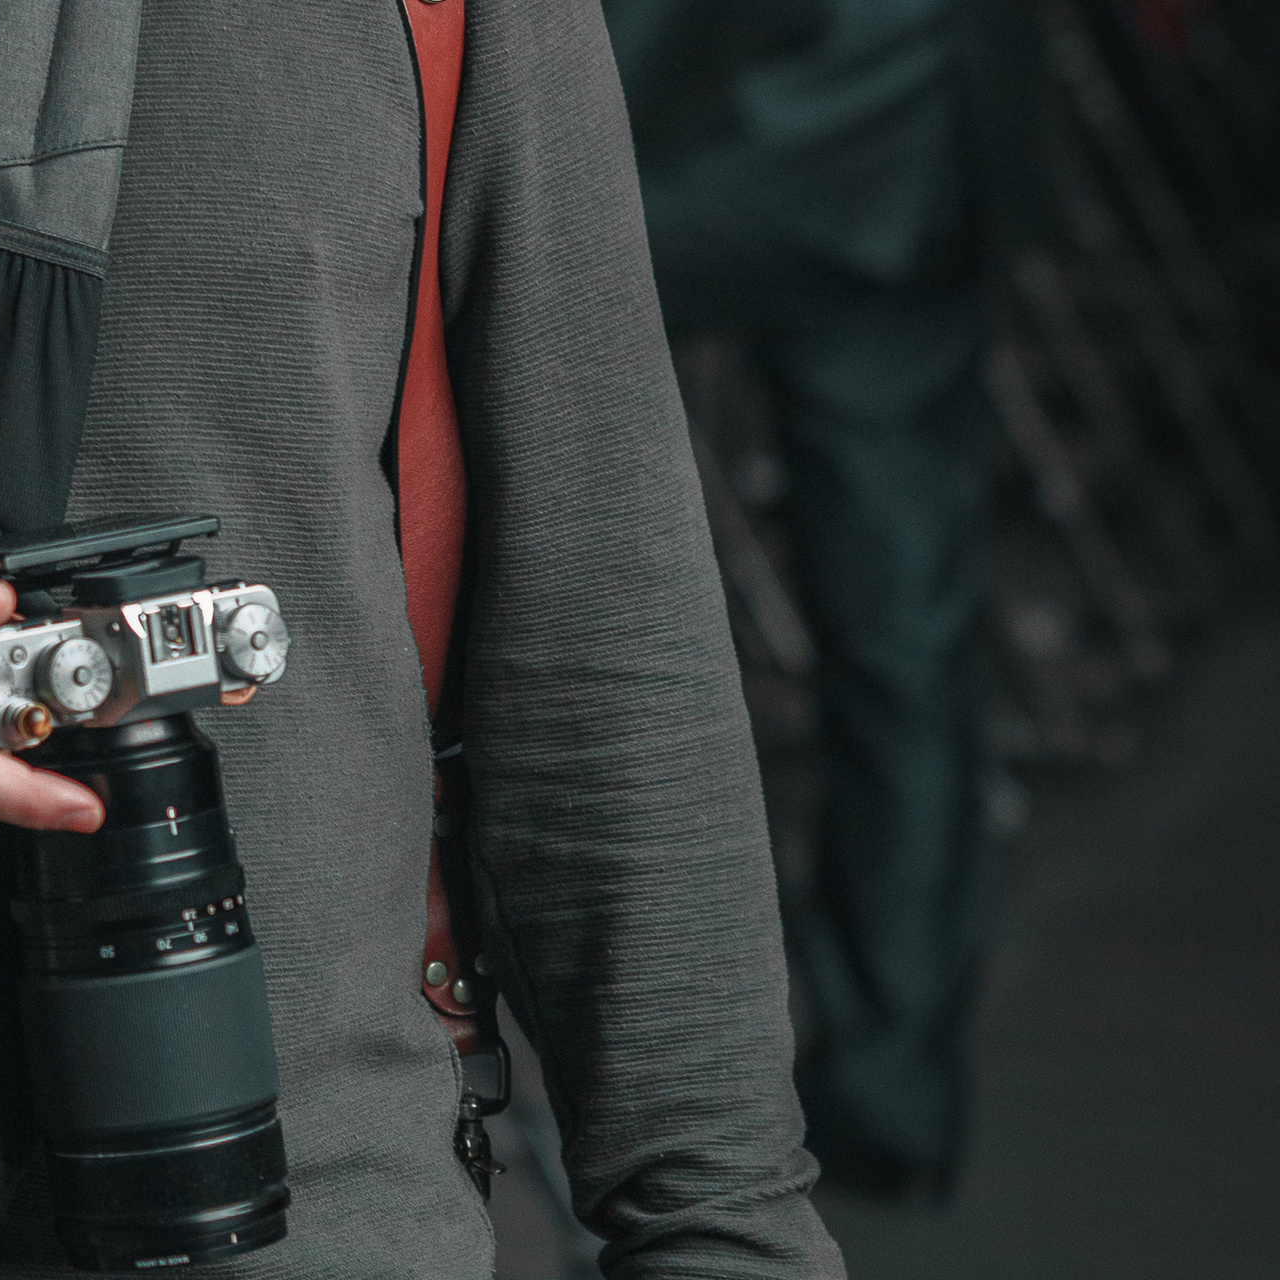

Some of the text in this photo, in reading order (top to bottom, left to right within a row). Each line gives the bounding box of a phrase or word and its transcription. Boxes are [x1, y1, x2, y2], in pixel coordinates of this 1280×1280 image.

[182, 908, 198, 921] 2.8
[156, 937, 173, 951] 70
[194, 930, 208, 944] 90
[100, 945, 116, 959] 50
